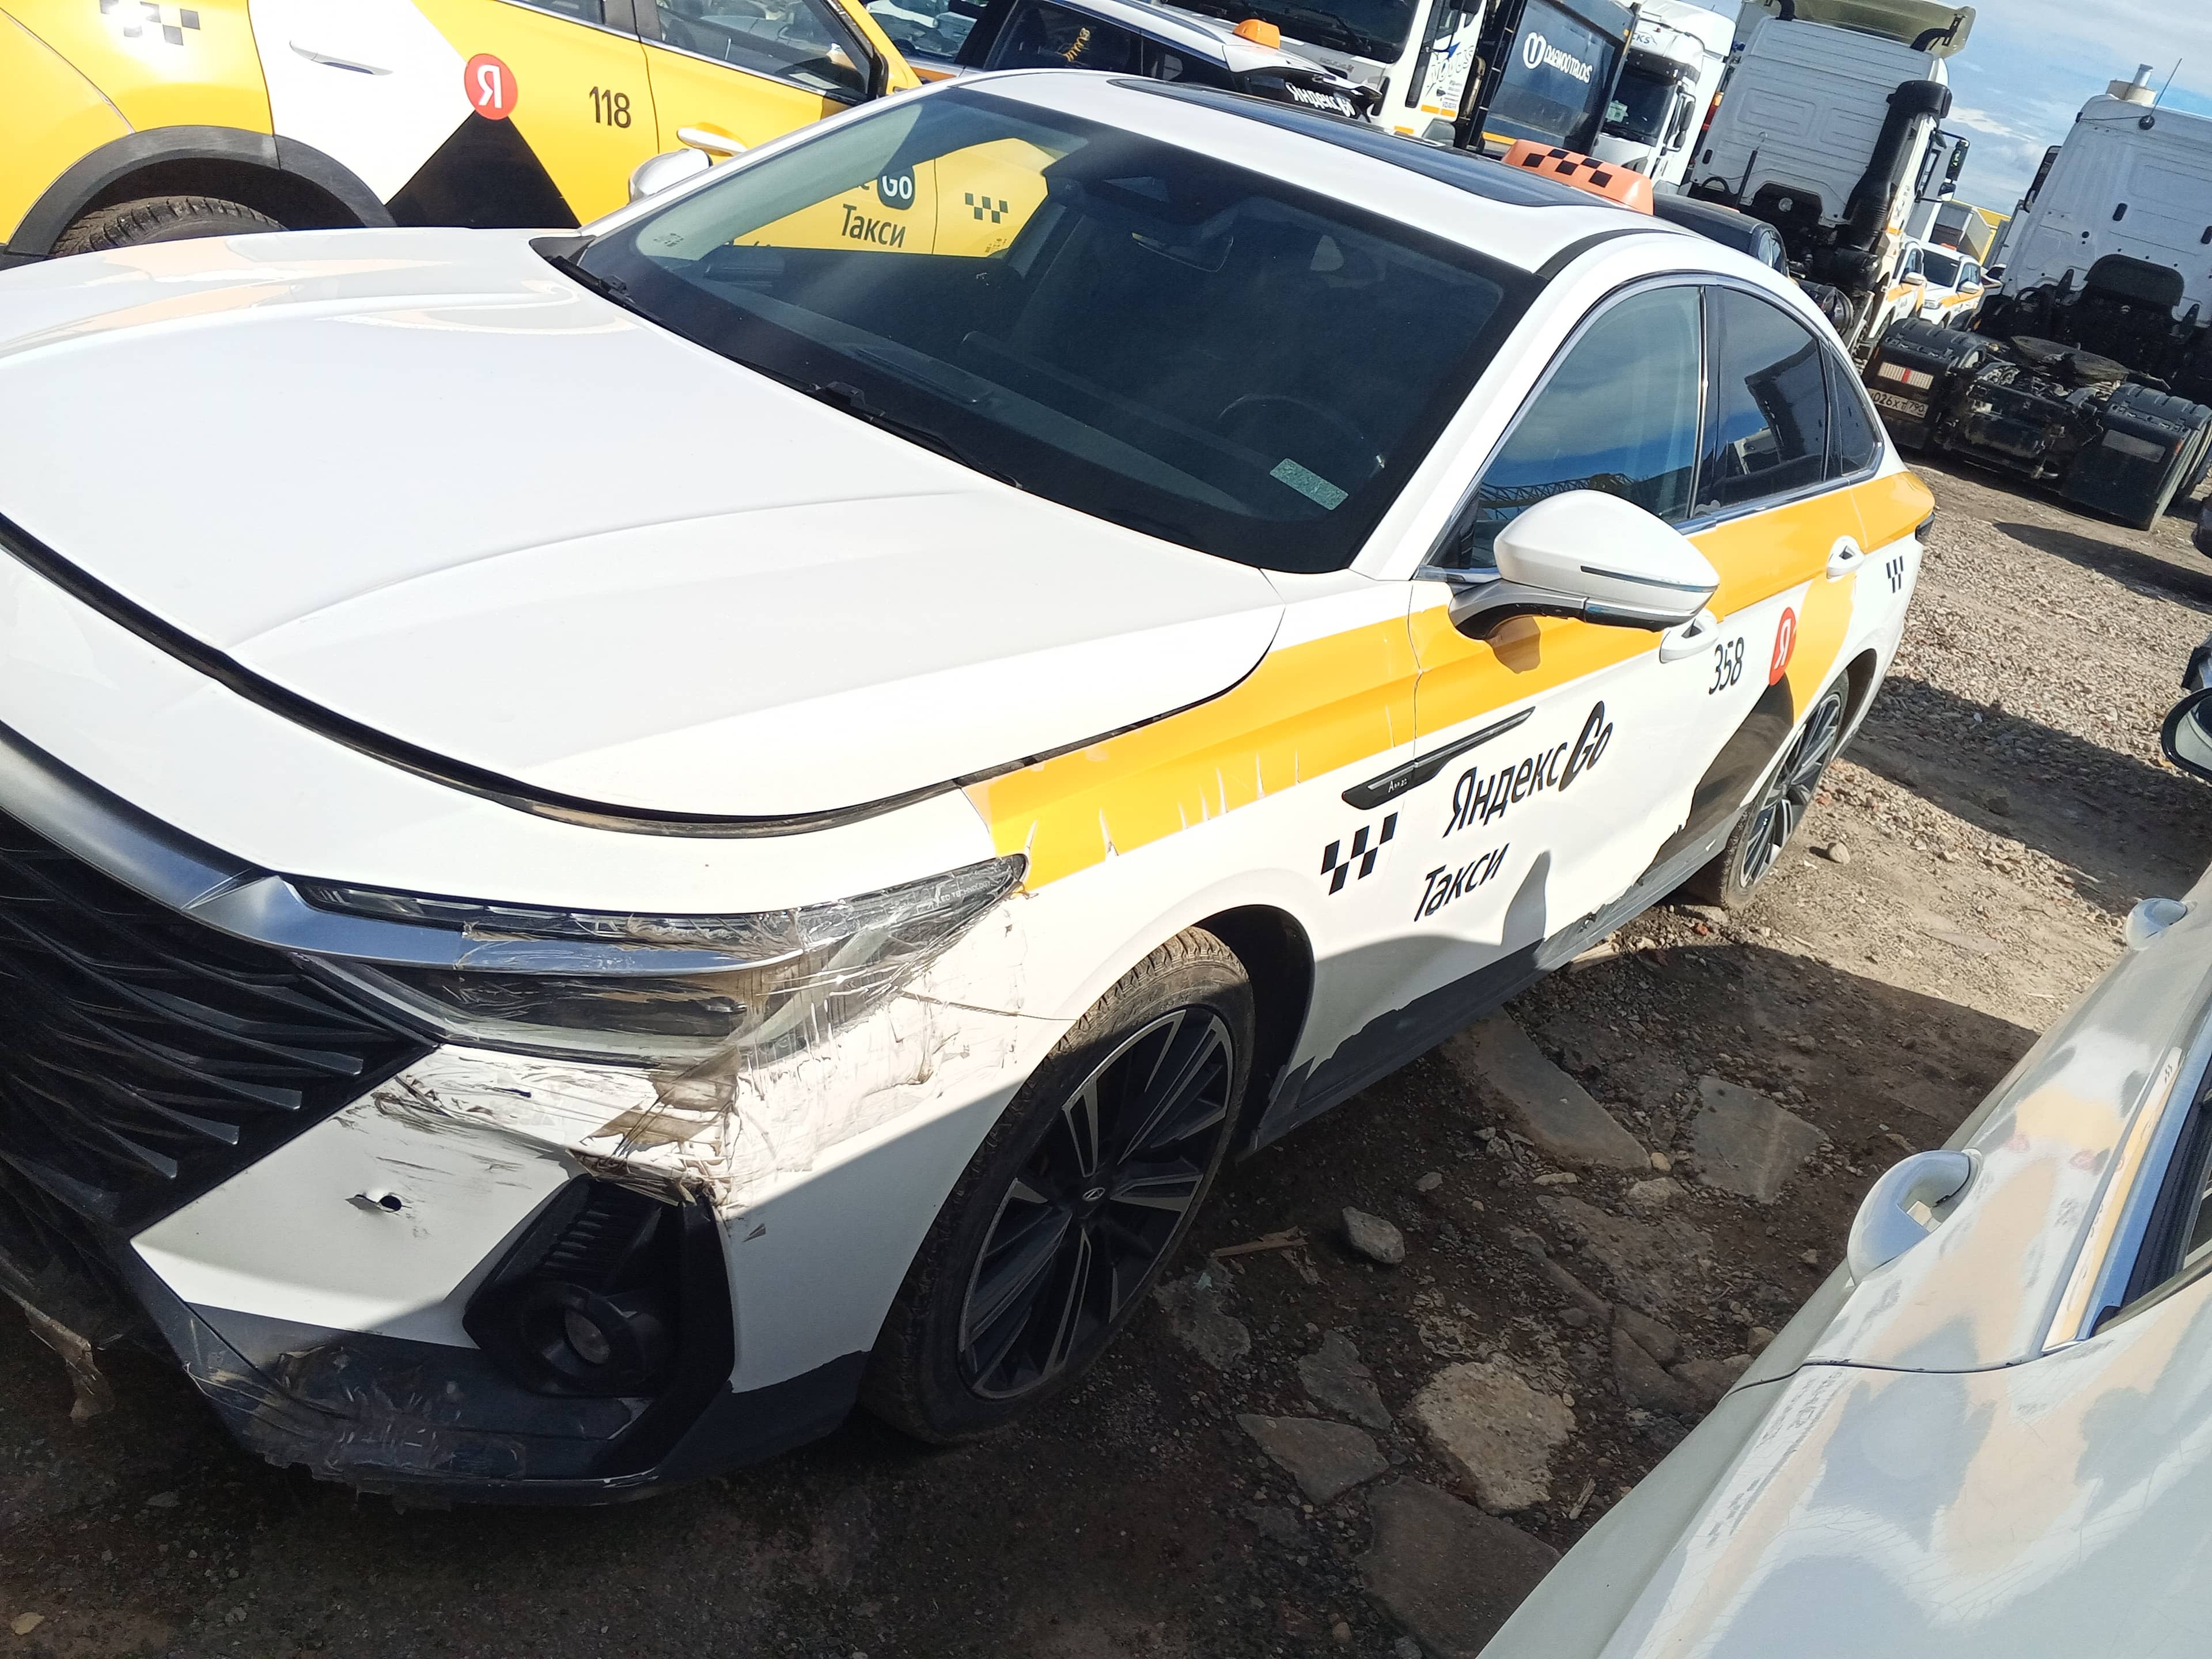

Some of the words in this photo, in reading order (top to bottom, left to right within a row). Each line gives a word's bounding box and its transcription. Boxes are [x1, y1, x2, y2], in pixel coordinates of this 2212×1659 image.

[476, 63, 503, 109] Я
[589, 86, 631, 128] 118
[882, 175, 912, 200] Go
[842, 203, 906, 248] Такси
[1709, 637, 1744, 695] 358
[1774, 618, 1791, 671] Я
[1442, 743, 1567, 839] Яндекс
[1558, 700, 1613, 792] Go
[1414, 843, 1510, 922] Такси
